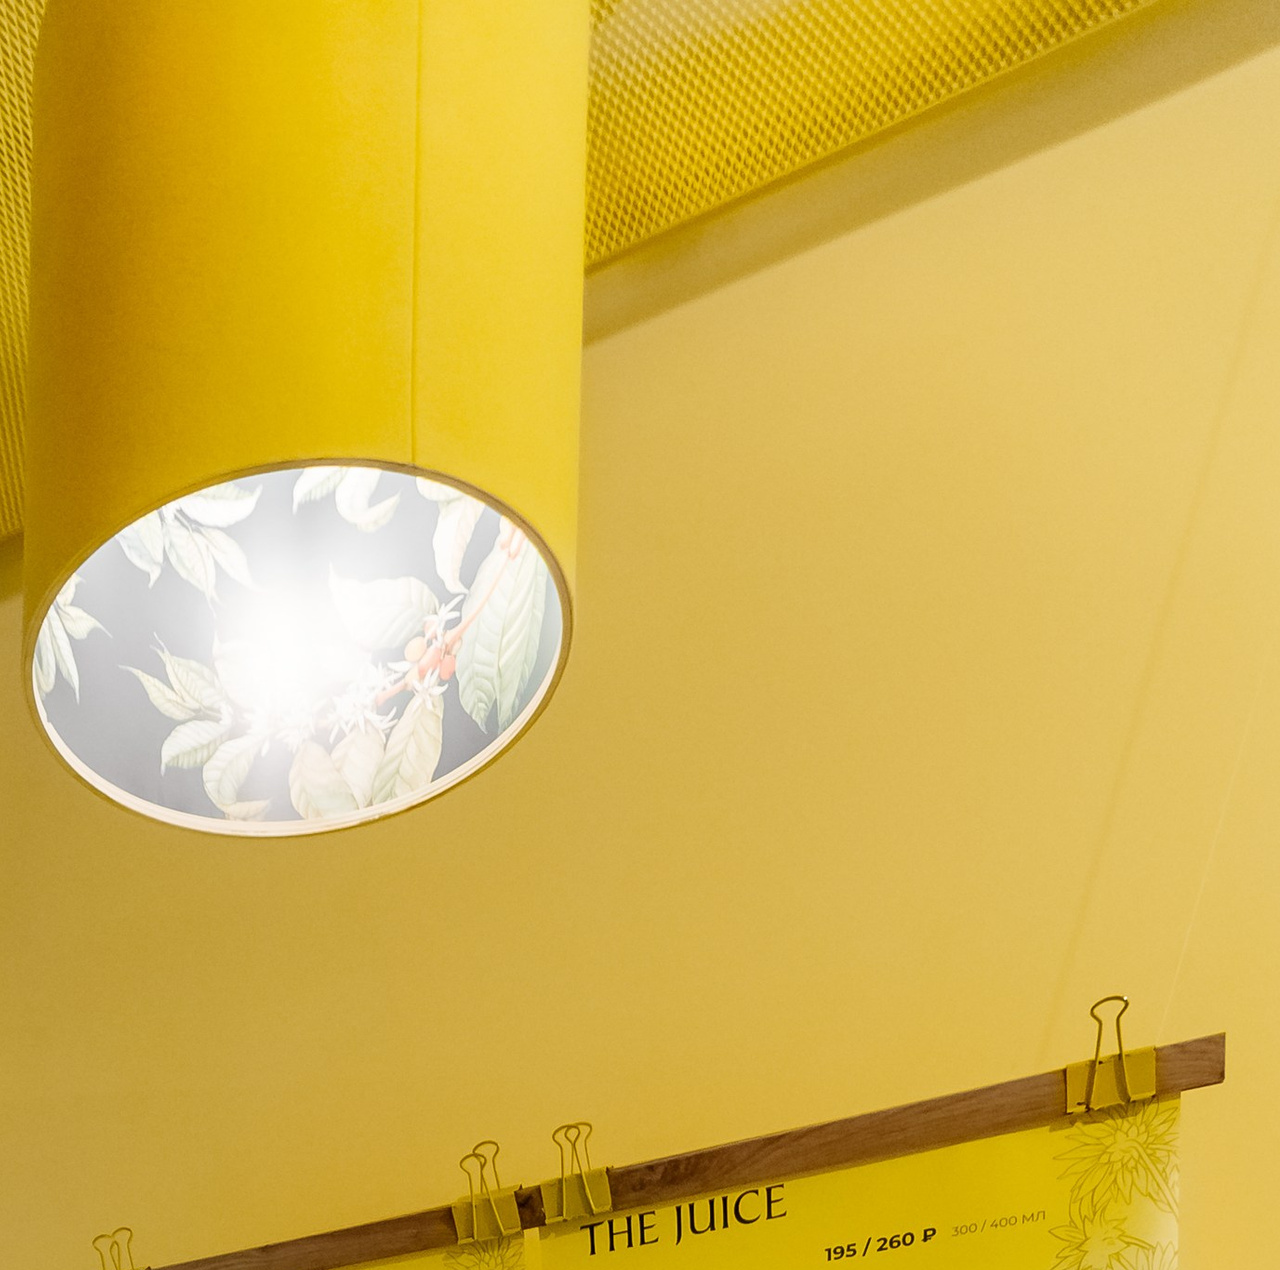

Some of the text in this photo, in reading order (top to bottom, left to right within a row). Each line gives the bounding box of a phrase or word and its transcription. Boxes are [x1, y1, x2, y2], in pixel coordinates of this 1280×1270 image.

[580, 1183, 787, 1256] THE JUICE
[824, 1242, 856, 1261] 195
[876, 1231, 914, 1252] 260
